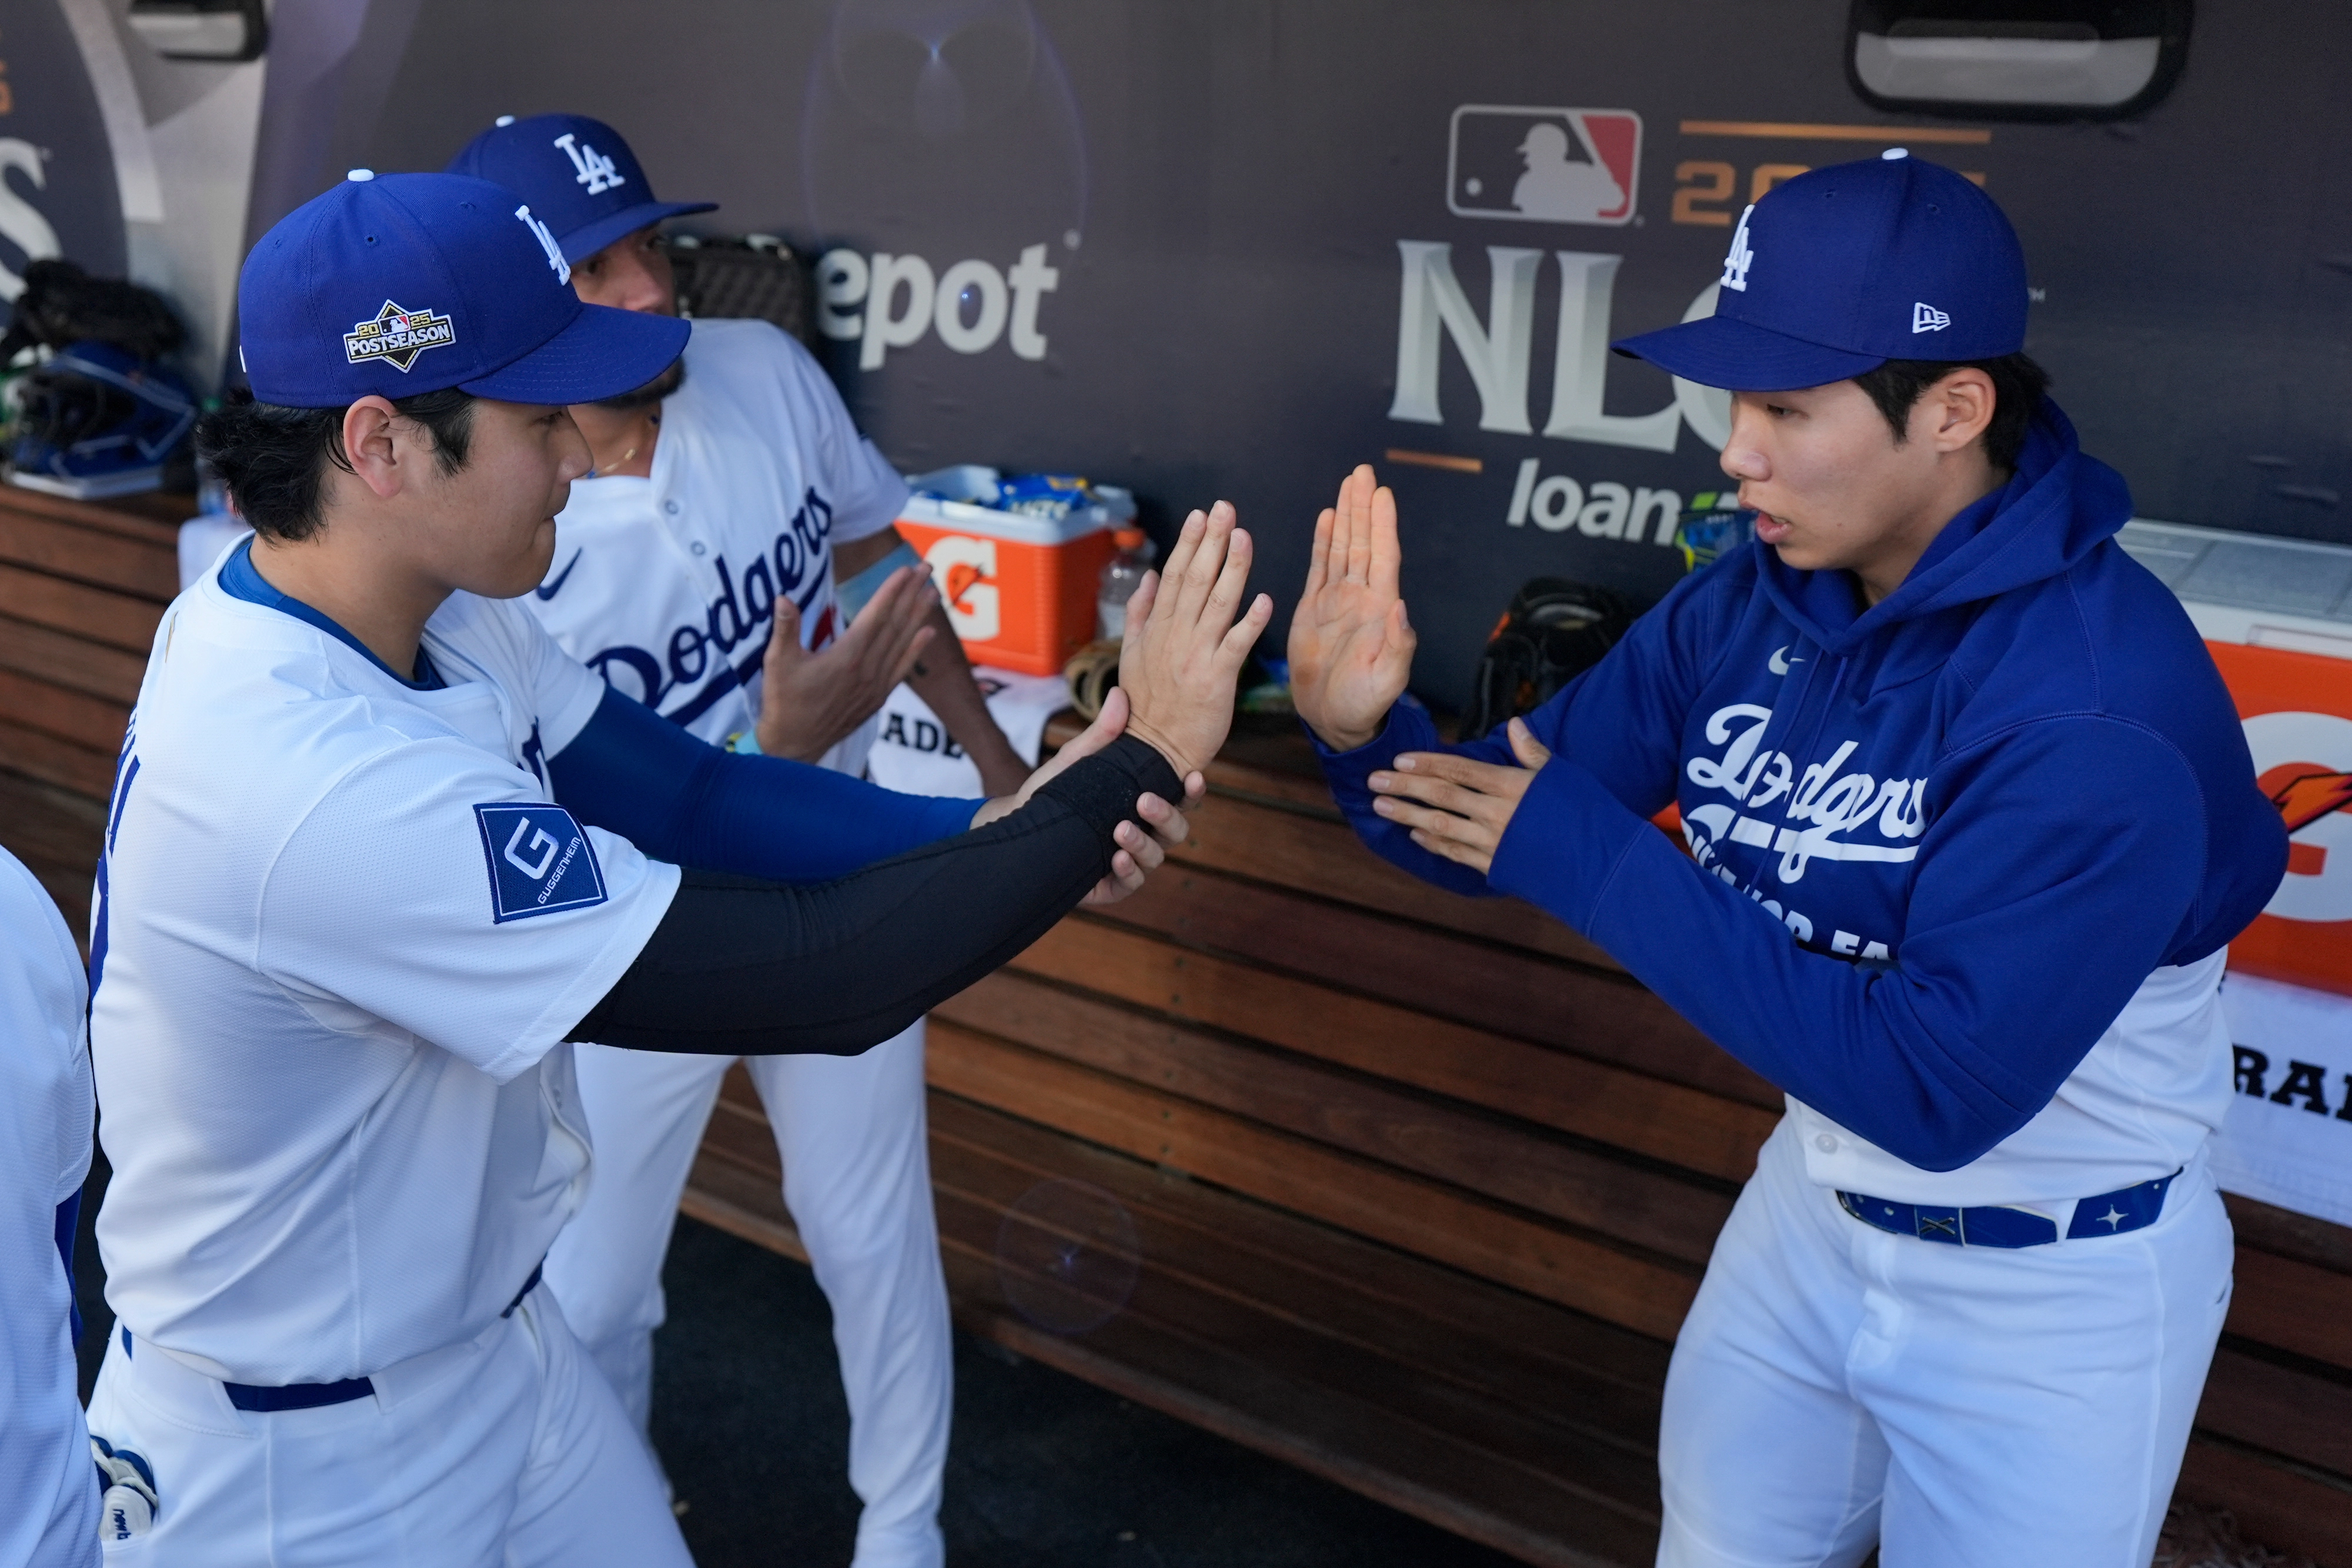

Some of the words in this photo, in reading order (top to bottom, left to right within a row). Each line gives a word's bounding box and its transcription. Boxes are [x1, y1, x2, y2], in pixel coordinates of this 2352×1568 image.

[554, 133, 625, 195] LA
[514, 205, 571, 286] LA
[1720, 204, 1754, 292] LA
[348, 324, 451, 356] POSTSEASON
[358, 323, 380, 337] 20
[409, 313, 431, 327] 25
[816, 242, 1059, 372] epot
[1506, 458, 1739, 547] loan
[585, 485, 833, 710] Dodgers
[923, 536, 1001, 641] G
[537, 836, 582, 905] GUGGENHEIM
